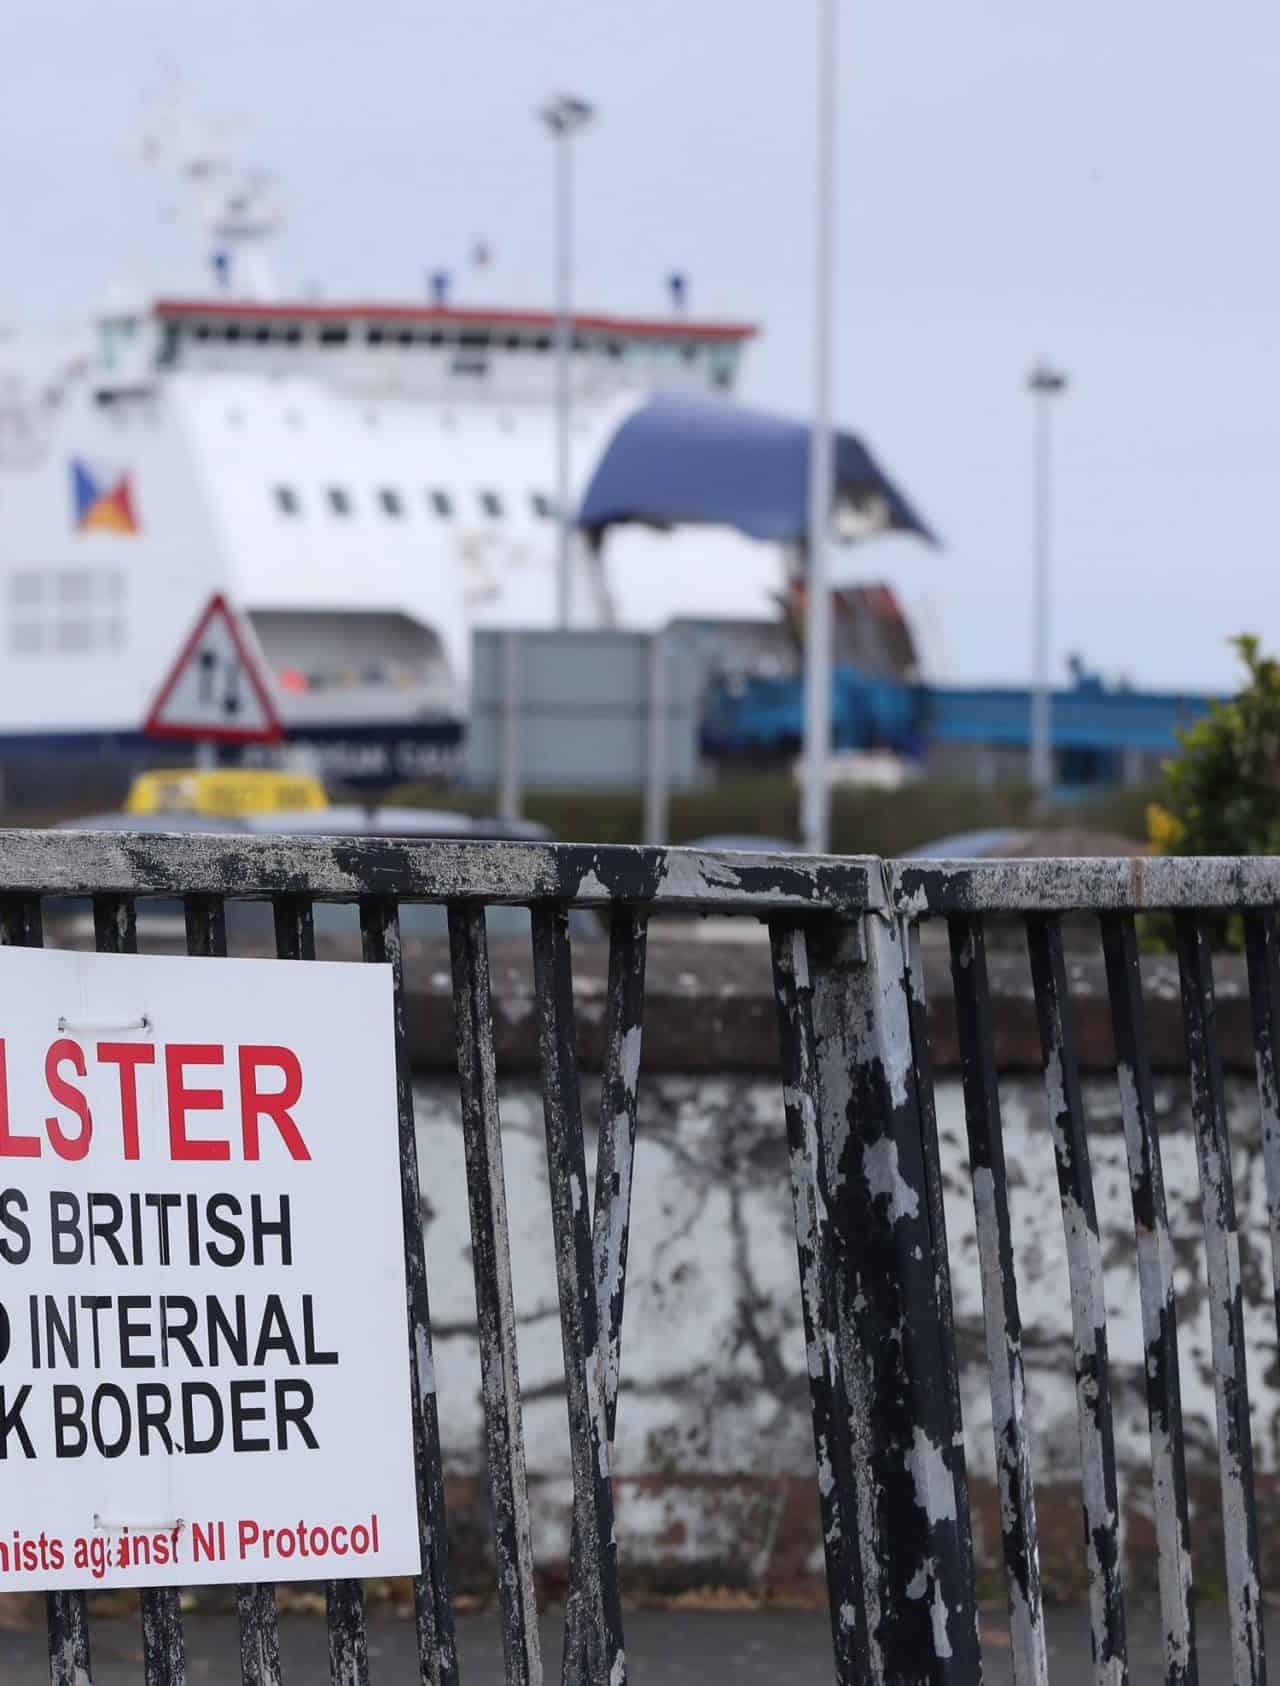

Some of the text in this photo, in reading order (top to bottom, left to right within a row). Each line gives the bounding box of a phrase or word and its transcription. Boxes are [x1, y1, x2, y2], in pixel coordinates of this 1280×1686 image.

[50, 1191, 293, 1267] BRITISH
[29, 1294, 339, 1369] INTERNAL
[53, 1379, 320, 1460] BORDER
[192, 1521, 226, 1563] NI
[239, 1515, 379, 1560] Protocol
